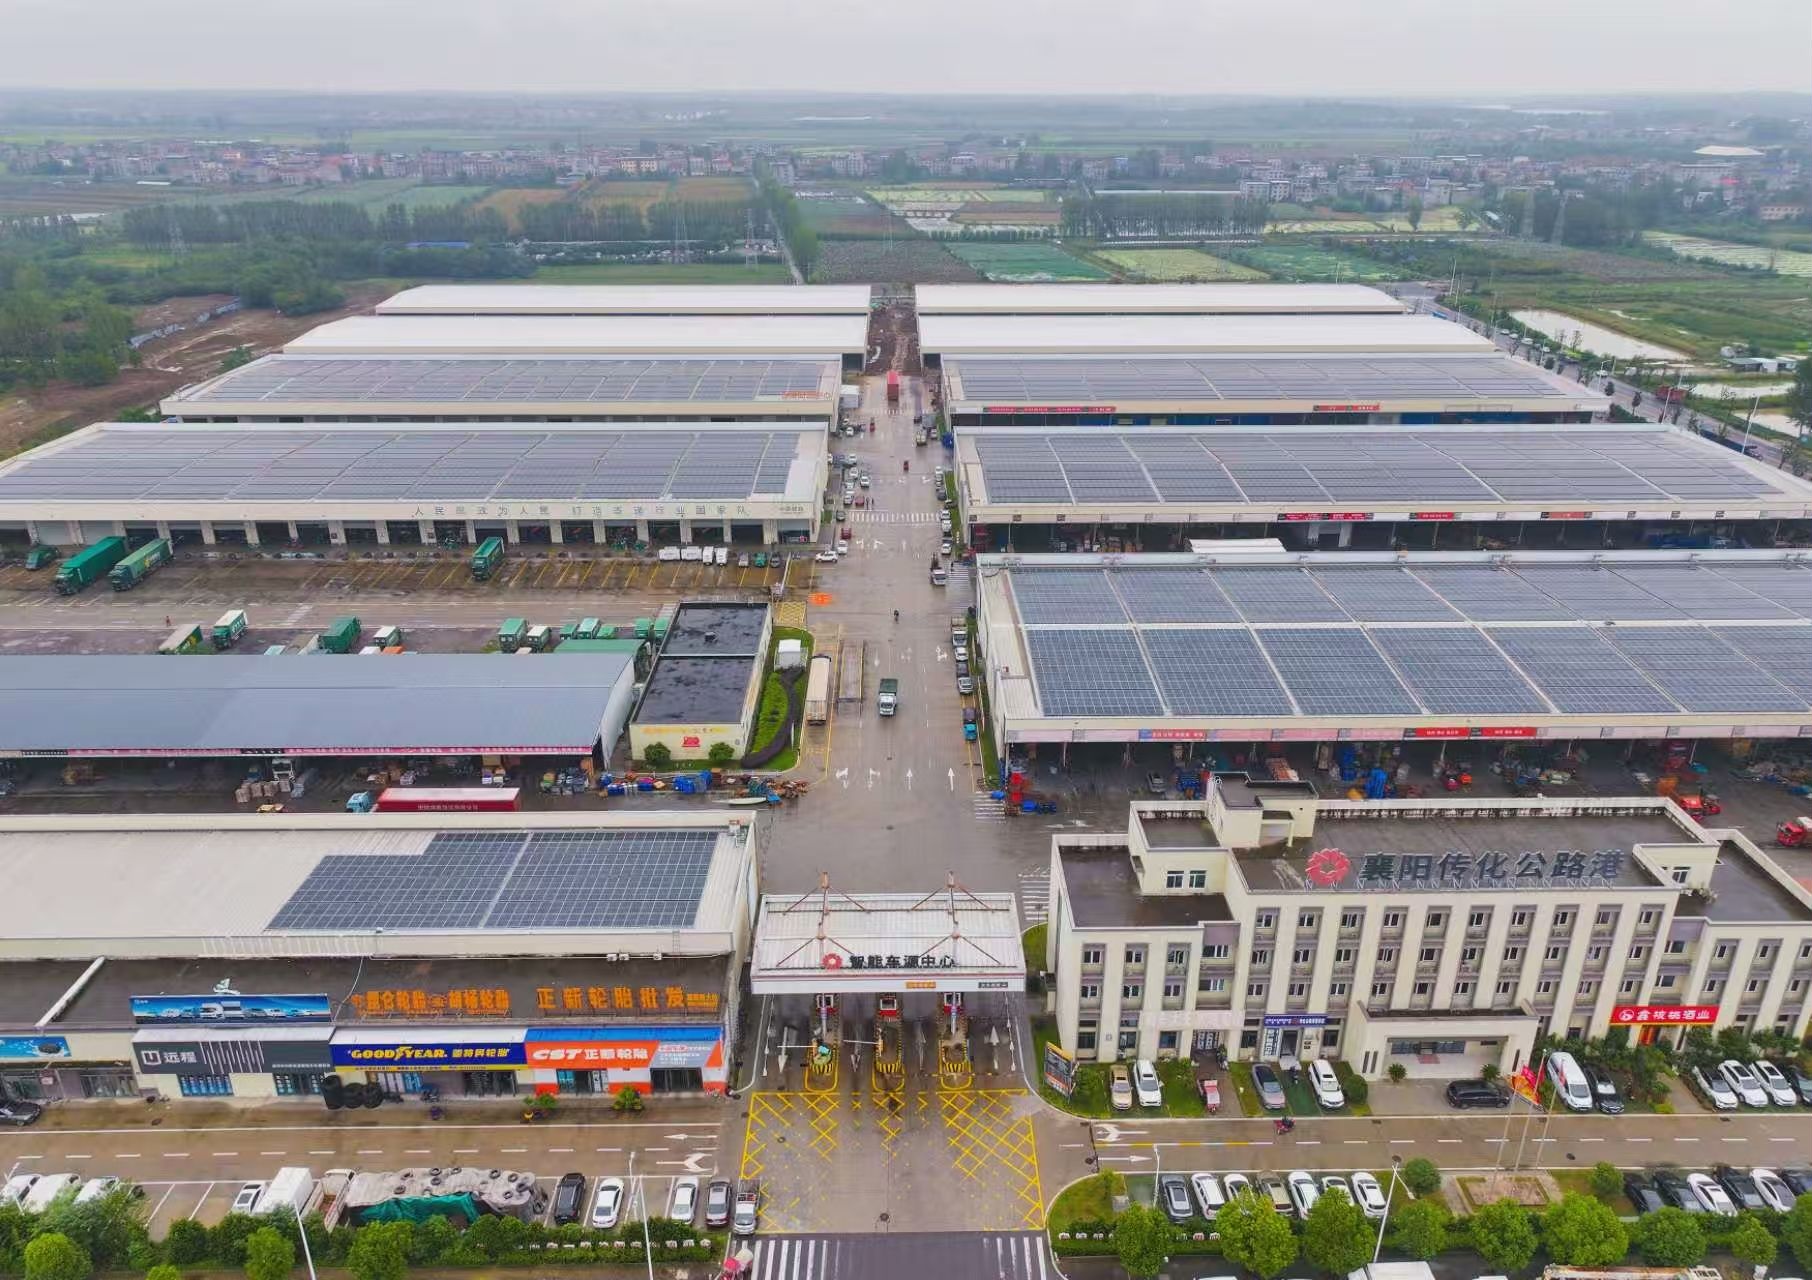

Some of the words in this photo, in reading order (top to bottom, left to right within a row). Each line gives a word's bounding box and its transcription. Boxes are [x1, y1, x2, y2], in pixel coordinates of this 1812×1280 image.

[1360, 850, 1625, 881] 襄阳传化公路港
[849, 954, 956, 969] 智能车源中心
[536, 986, 685, 1009] 正新轮胎批发
[164, 1051, 197, 1064] 远程
[351, 1046, 446, 1060] GOODYEAR
[532, 1048, 584, 1060] CST
